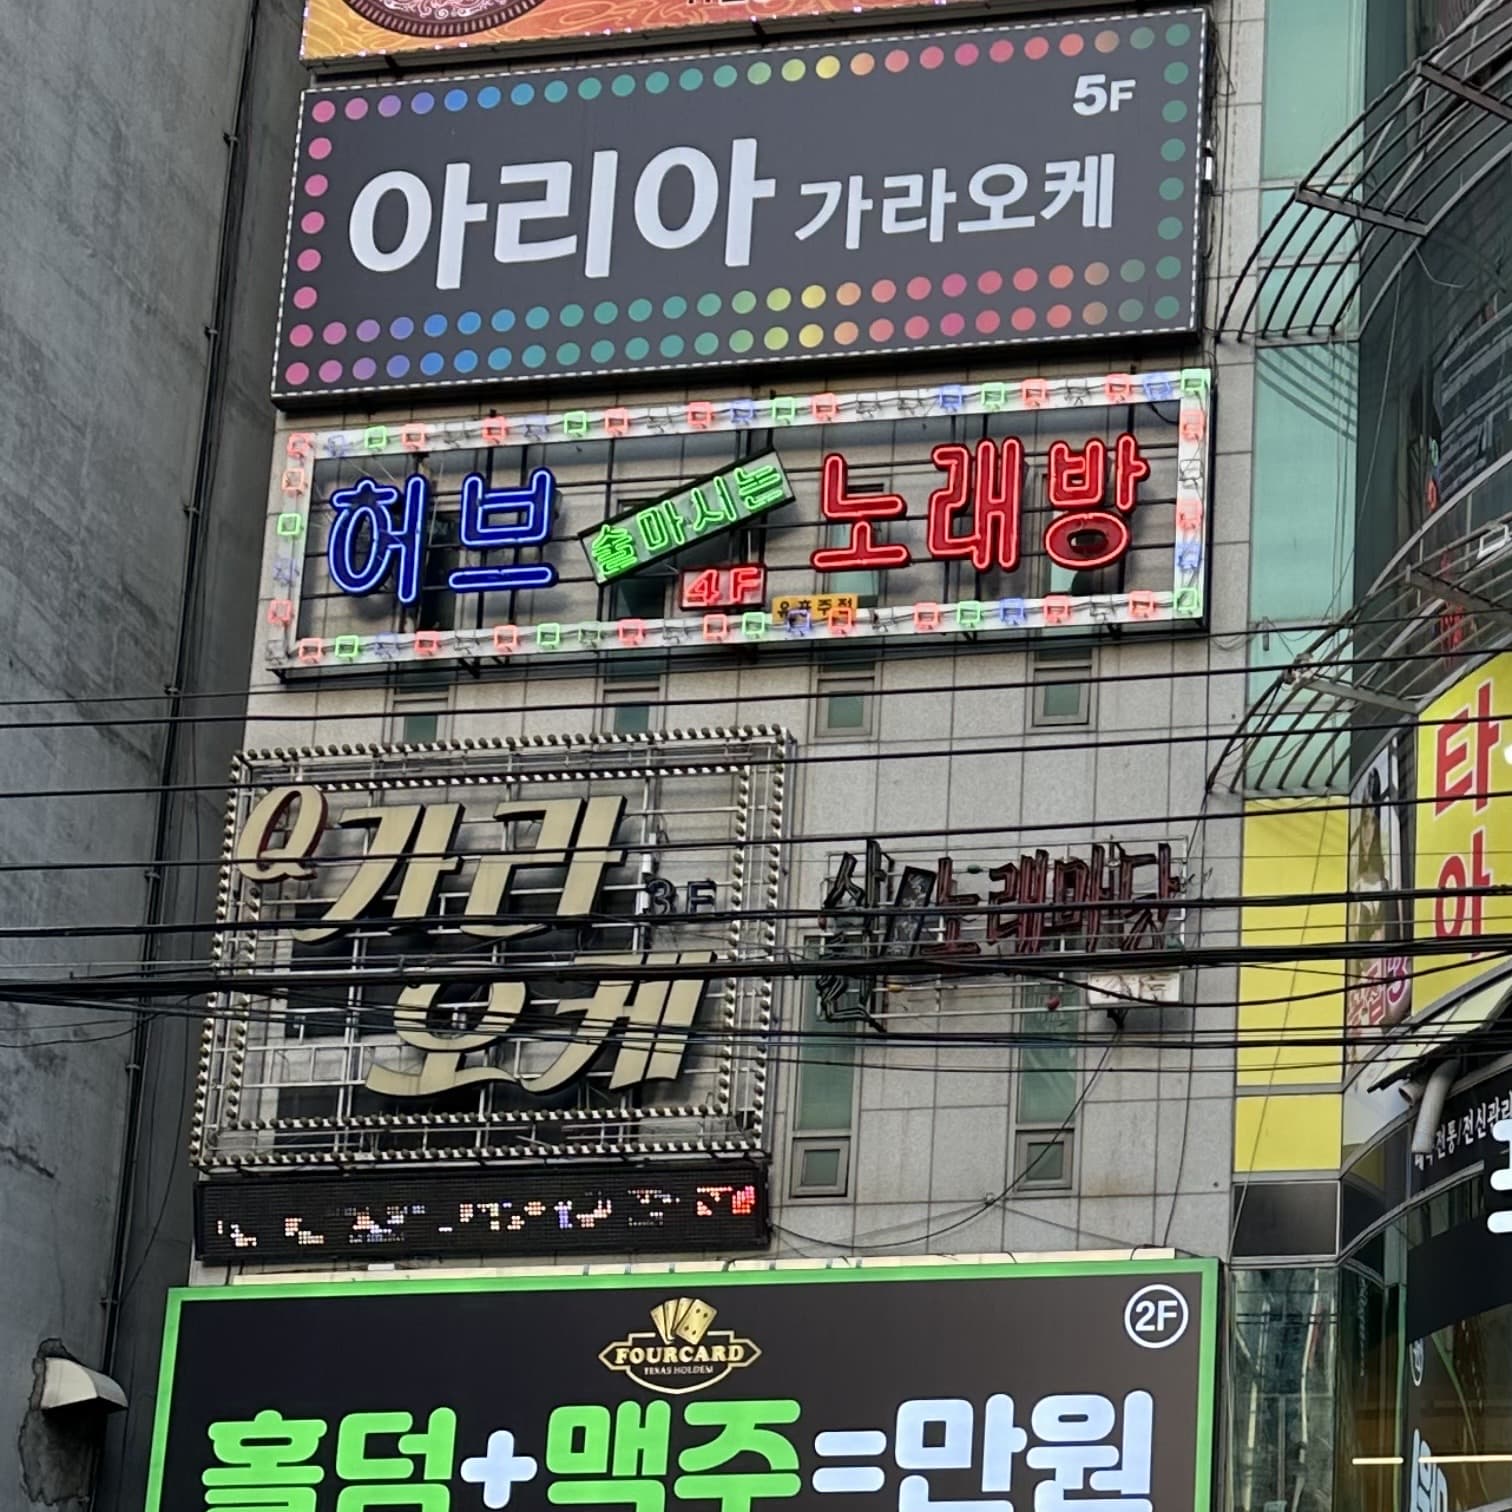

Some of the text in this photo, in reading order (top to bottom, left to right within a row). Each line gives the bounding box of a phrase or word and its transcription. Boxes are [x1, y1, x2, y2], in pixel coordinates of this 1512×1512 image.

[1072, 73, 1137, 116] 5F
[348, 137, 1117, 290] 아리아 가라오케
[810, 433, 1151, 571] 노래방
[326, 465, 557, 606] 허브
[686, 567, 764, 605] 4F
[237, 784, 328, 881] Q
[1135, 1300, 1180, 1335] 2F
[614, 1345, 745, 1365] FOURCARD
[643, 1365, 714, 1375] TEXAS HOLDEM
